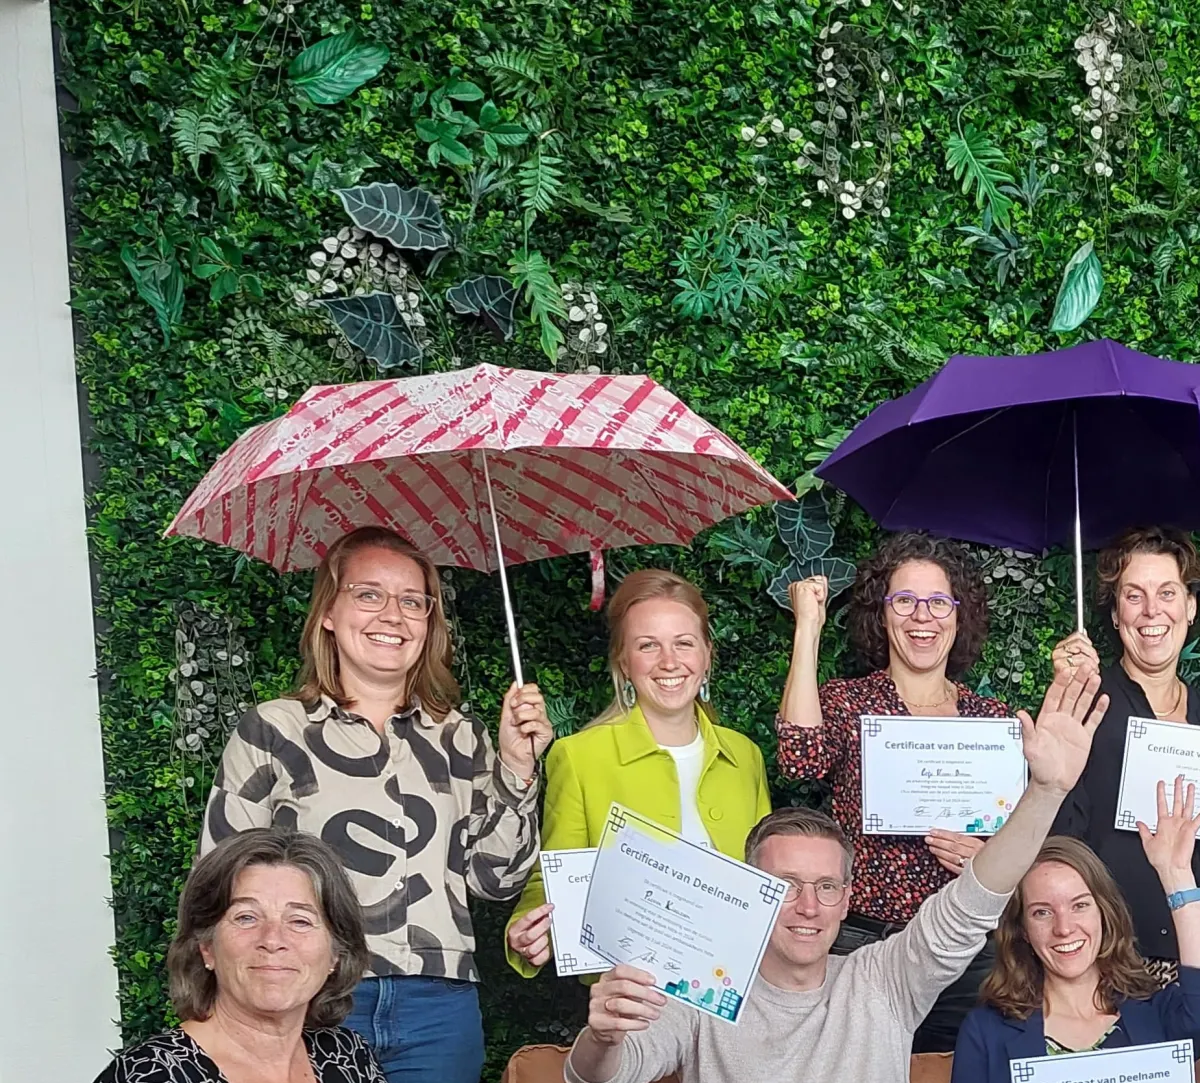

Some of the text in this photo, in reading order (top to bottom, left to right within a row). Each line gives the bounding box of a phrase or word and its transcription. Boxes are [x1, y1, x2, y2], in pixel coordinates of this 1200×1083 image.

[885, 741, 934, 750] Certificaat
[958, 742, 1005, 751] Deelname
[1148, 744, 1194, 757] Certificaat
[620, 843, 670, 875] Certificaat
[671, 868, 691, 884] van
[693, 878, 749, 910] Deelname
[1119, 1070, 1170, 1083] Deelname
